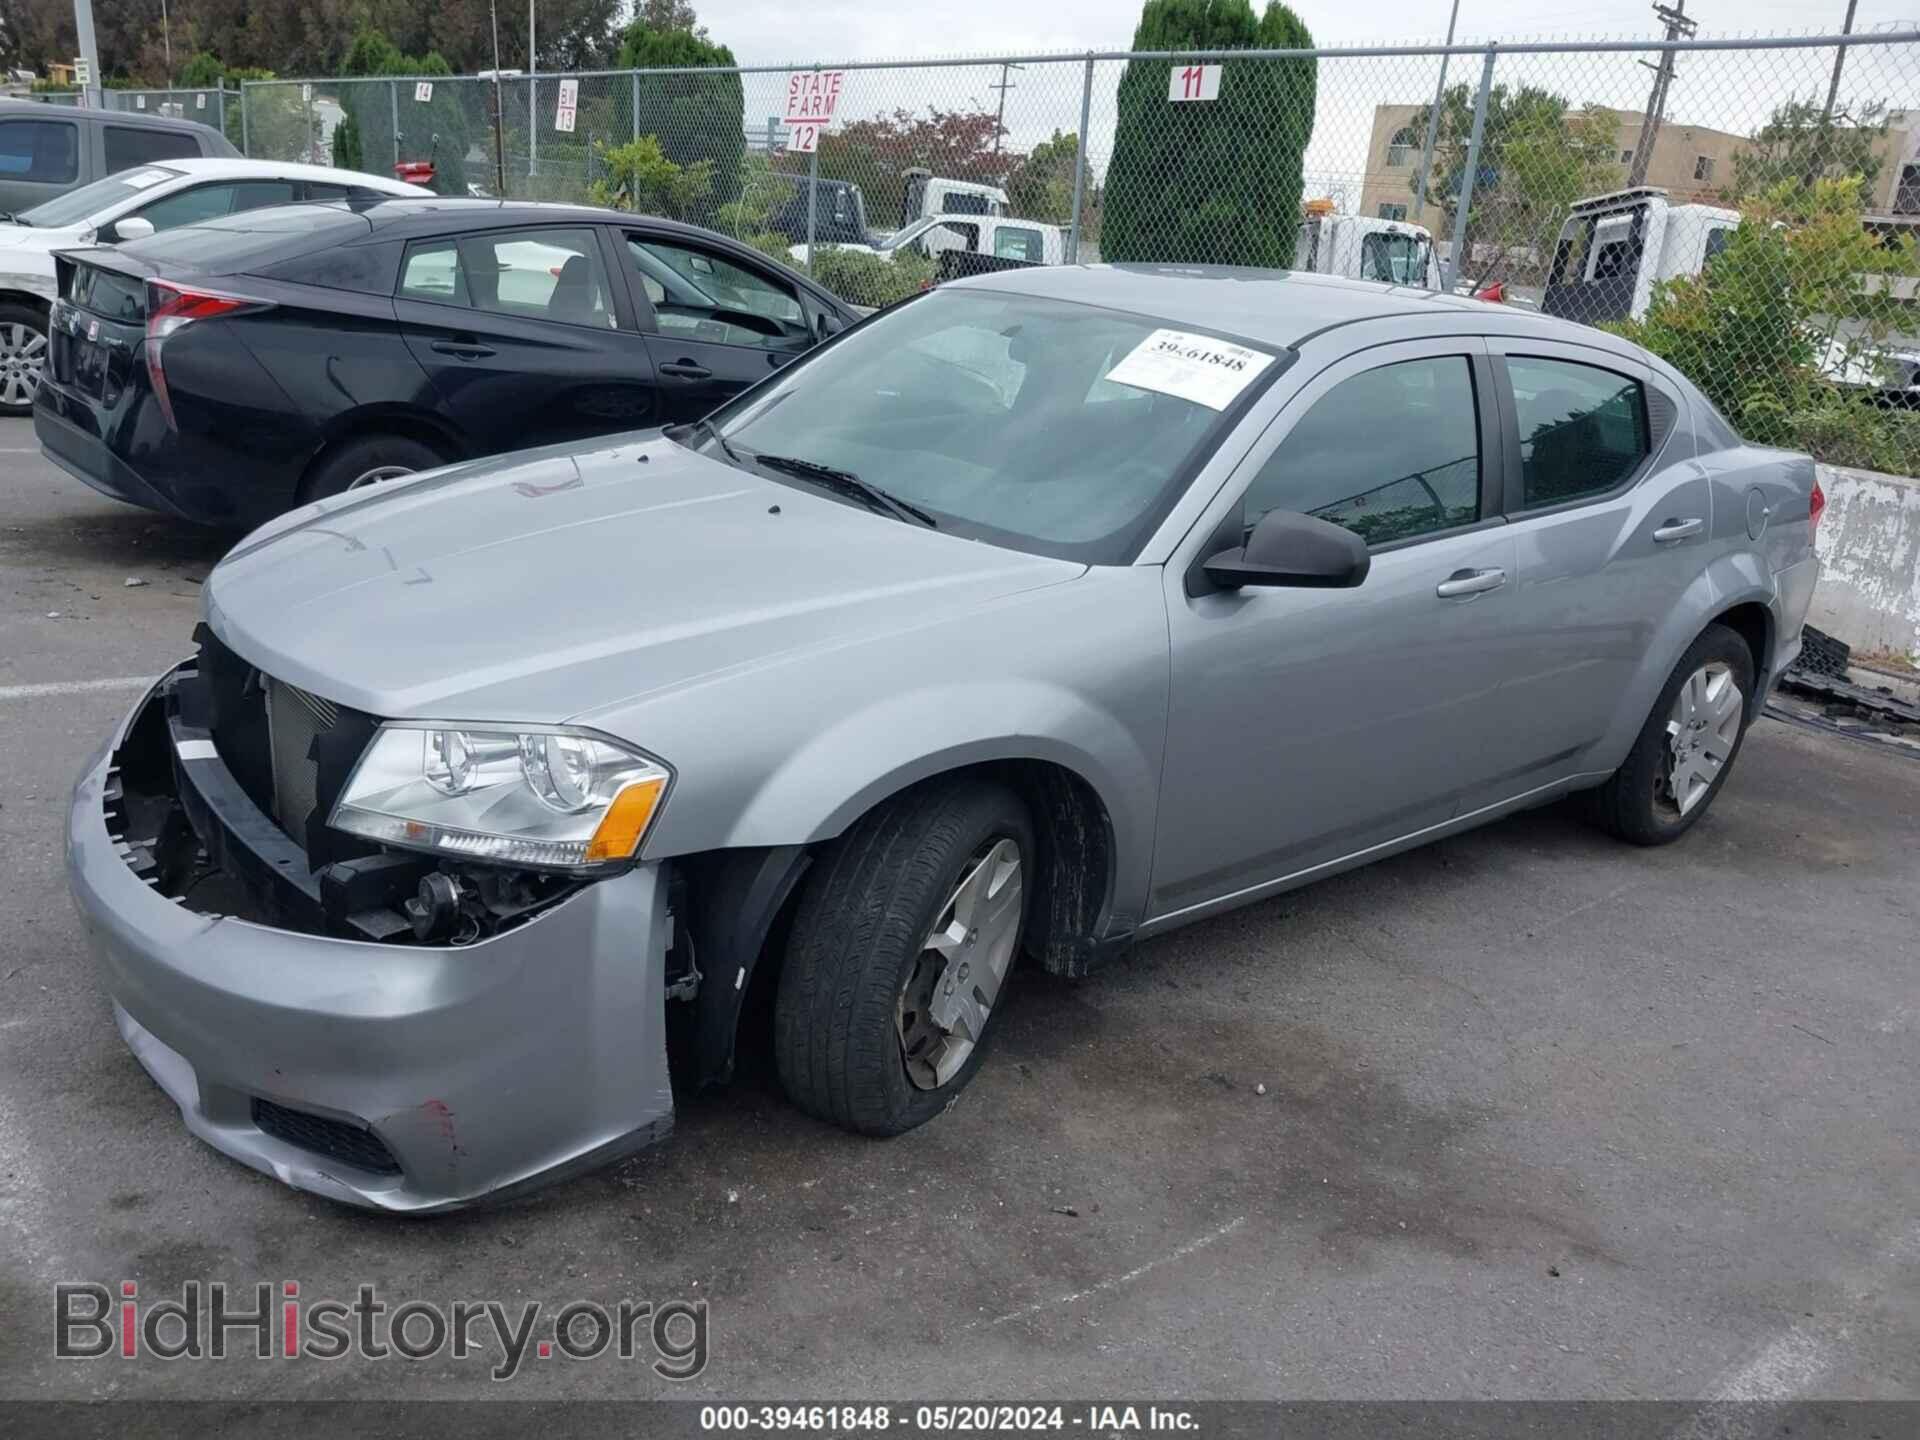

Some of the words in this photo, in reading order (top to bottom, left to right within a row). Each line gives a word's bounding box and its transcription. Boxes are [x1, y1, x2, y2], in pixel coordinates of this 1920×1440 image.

[789, 72, 842, 95] STATE
[1182, 66, 1203, 99] 11
[787, 94, 836, 116] FARM
[560, 111, 573, 130] 13
[794, 125, 815, 150] 12
